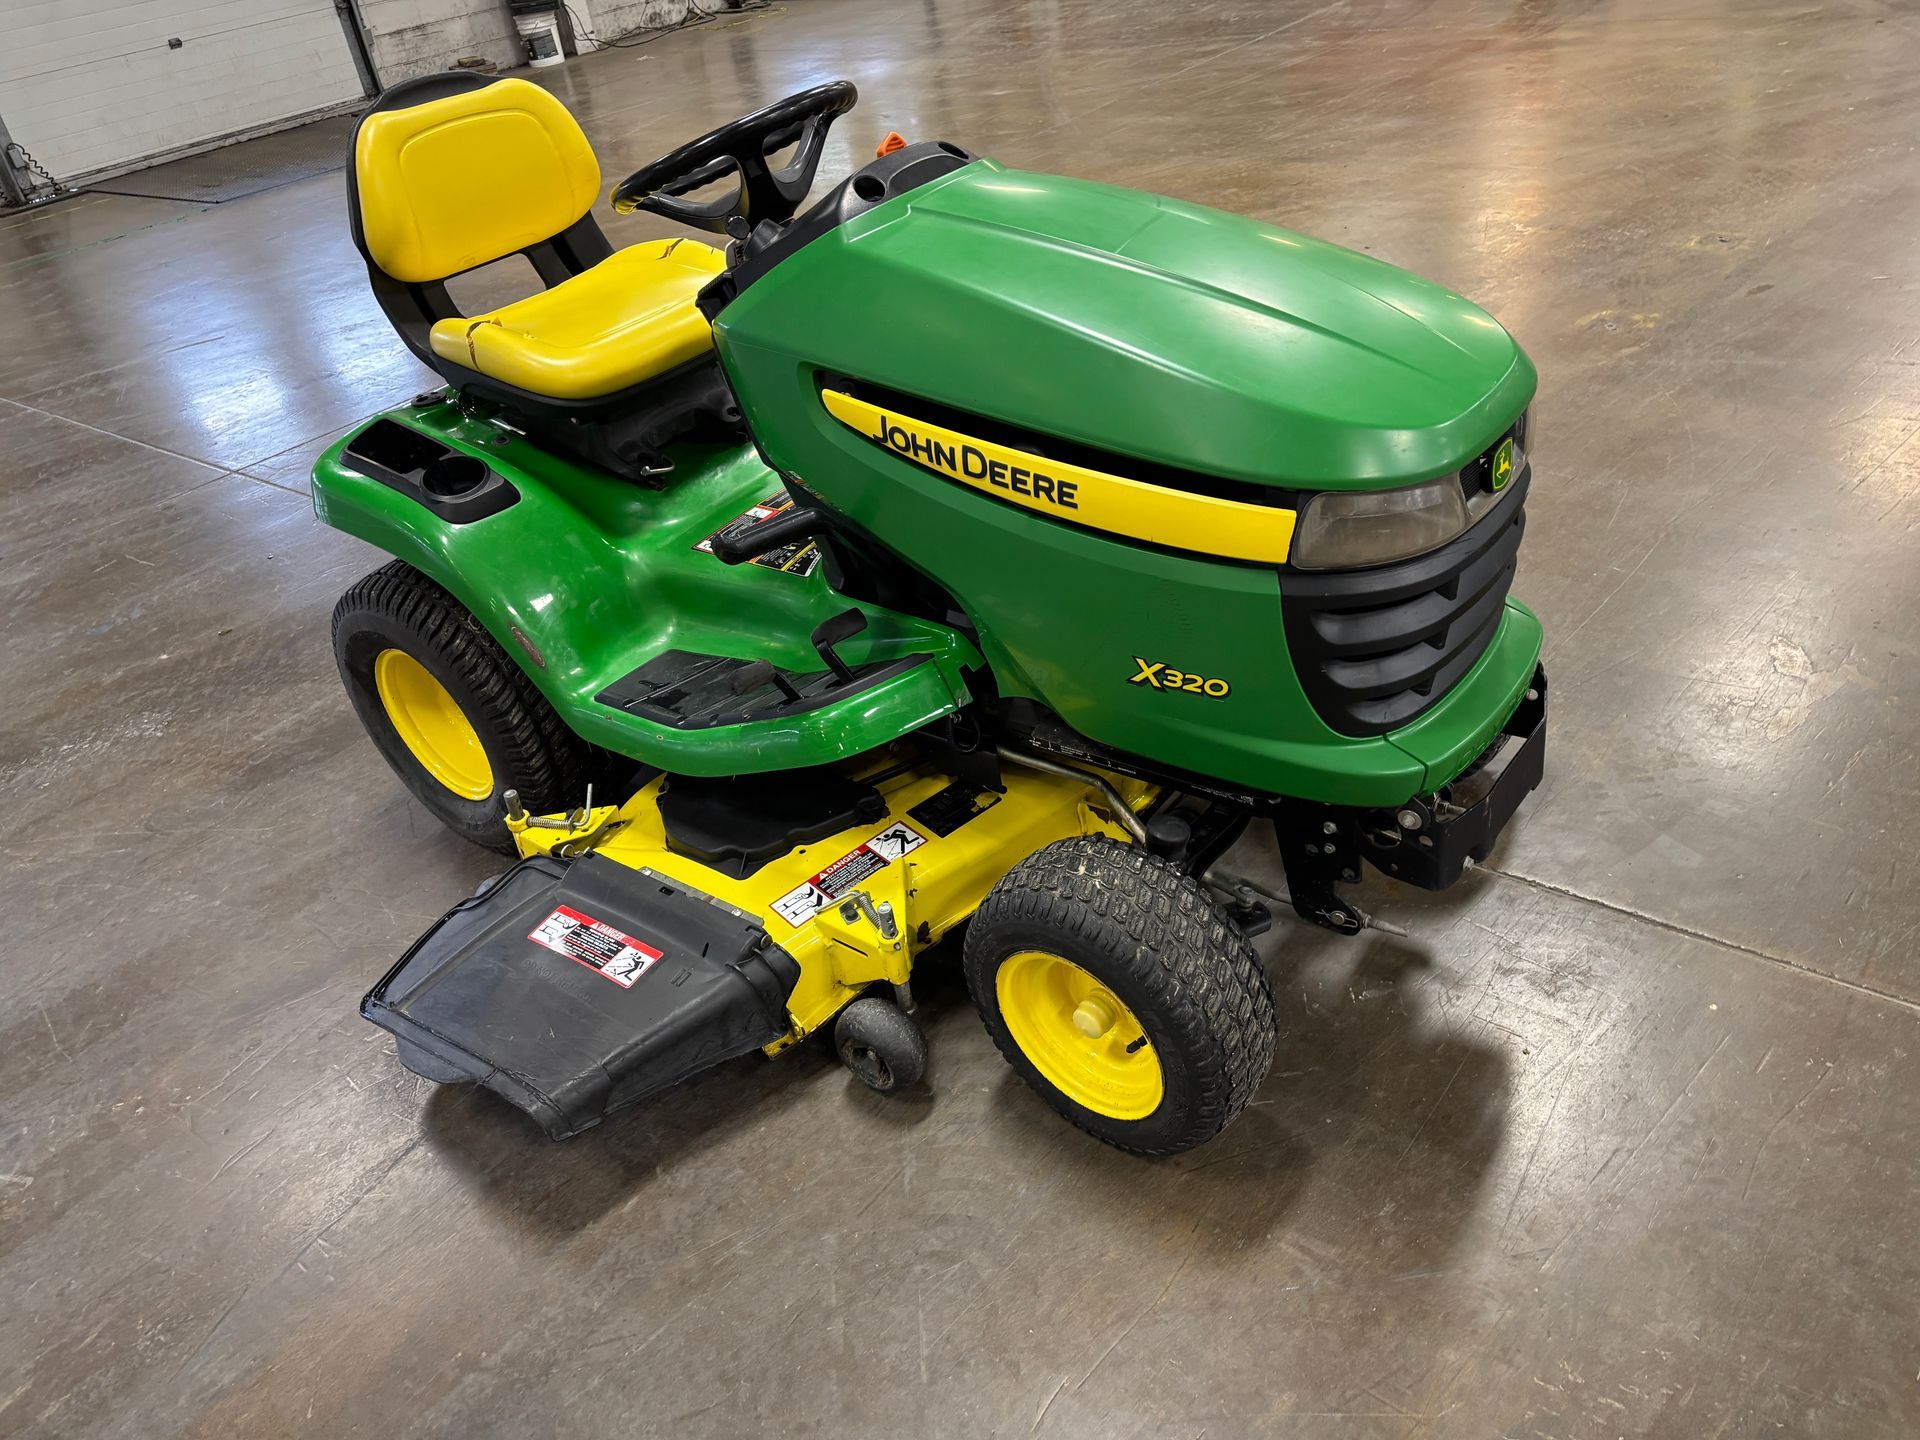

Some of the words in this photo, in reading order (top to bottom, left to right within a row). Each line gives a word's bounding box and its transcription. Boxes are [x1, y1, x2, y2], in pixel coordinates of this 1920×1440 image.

[872, 415, 957, 472] JOHN
[962, 444, 1079, 510] DEERE
[1128, 657, 1231, 698] X320
[826, 849, 861, 874] DANGER
[597, 922, 626, 941] DANGER
